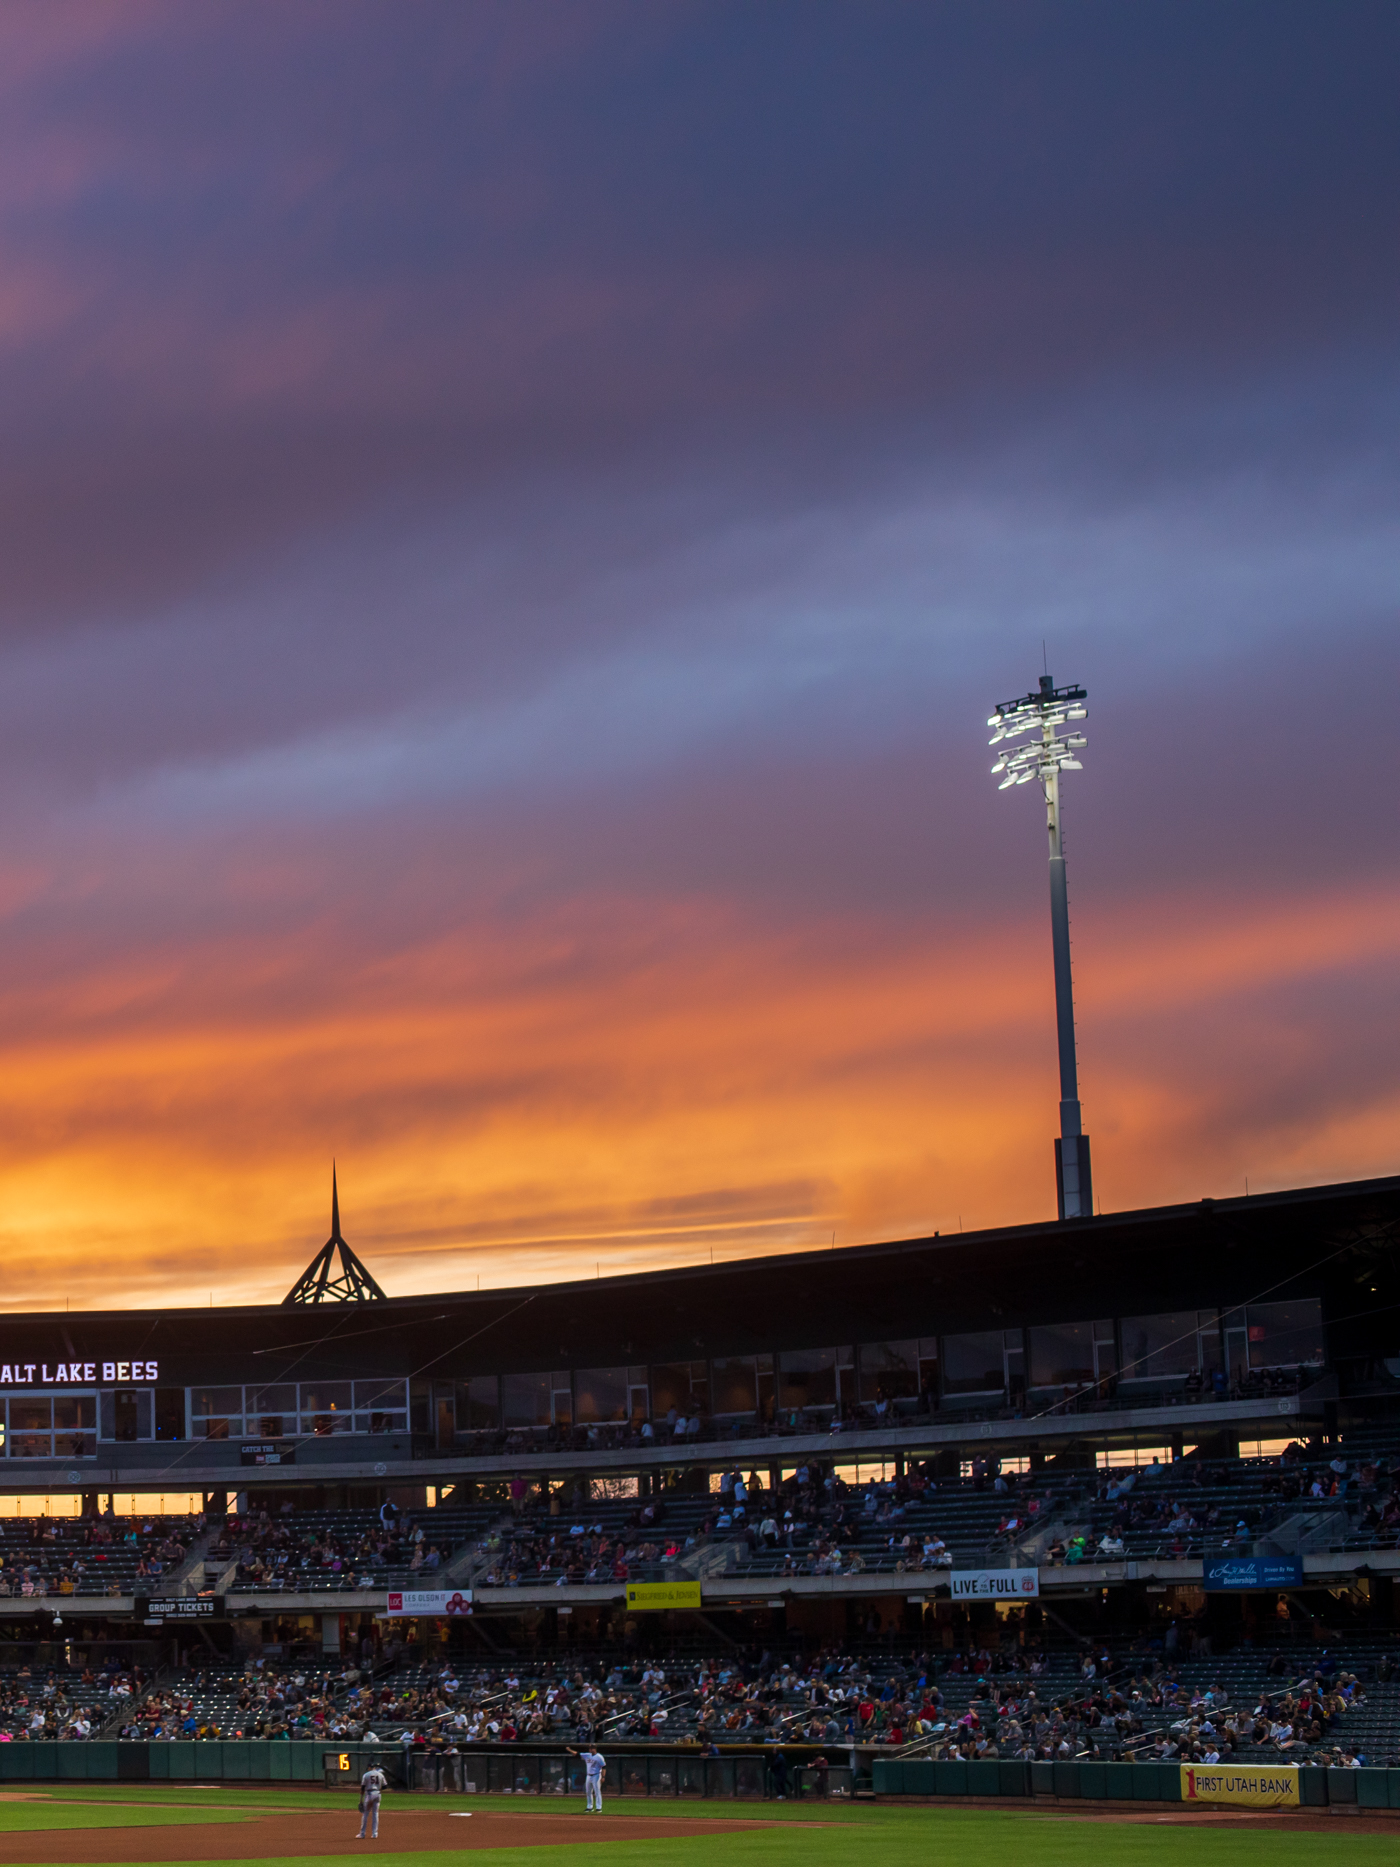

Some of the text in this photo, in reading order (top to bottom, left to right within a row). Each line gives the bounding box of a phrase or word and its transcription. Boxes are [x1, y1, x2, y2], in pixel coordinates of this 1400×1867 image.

[42, 1363, 96, 1382] LAKE
[102, 1361, 158, 1381] BEES
[954, 1580, 978, 1594] LIVE
[990, 1579, 1017, 1592] FULL
[405, 1594, 416, 1602] LES
[636, 1592, 667, 1600] SIEGFRIED
[676, 1591, 698, 1600] JENSEN
[390, 1598, 401, 1606] LOC
[149, 1603, 214, 1612] GROUP TICKETS
[371, 1776, 379, 1784] 51
[1186, 1769, 1198, 1798] 1
[1196, 1777, 1293, 1793] FIRST UTAH BANK
